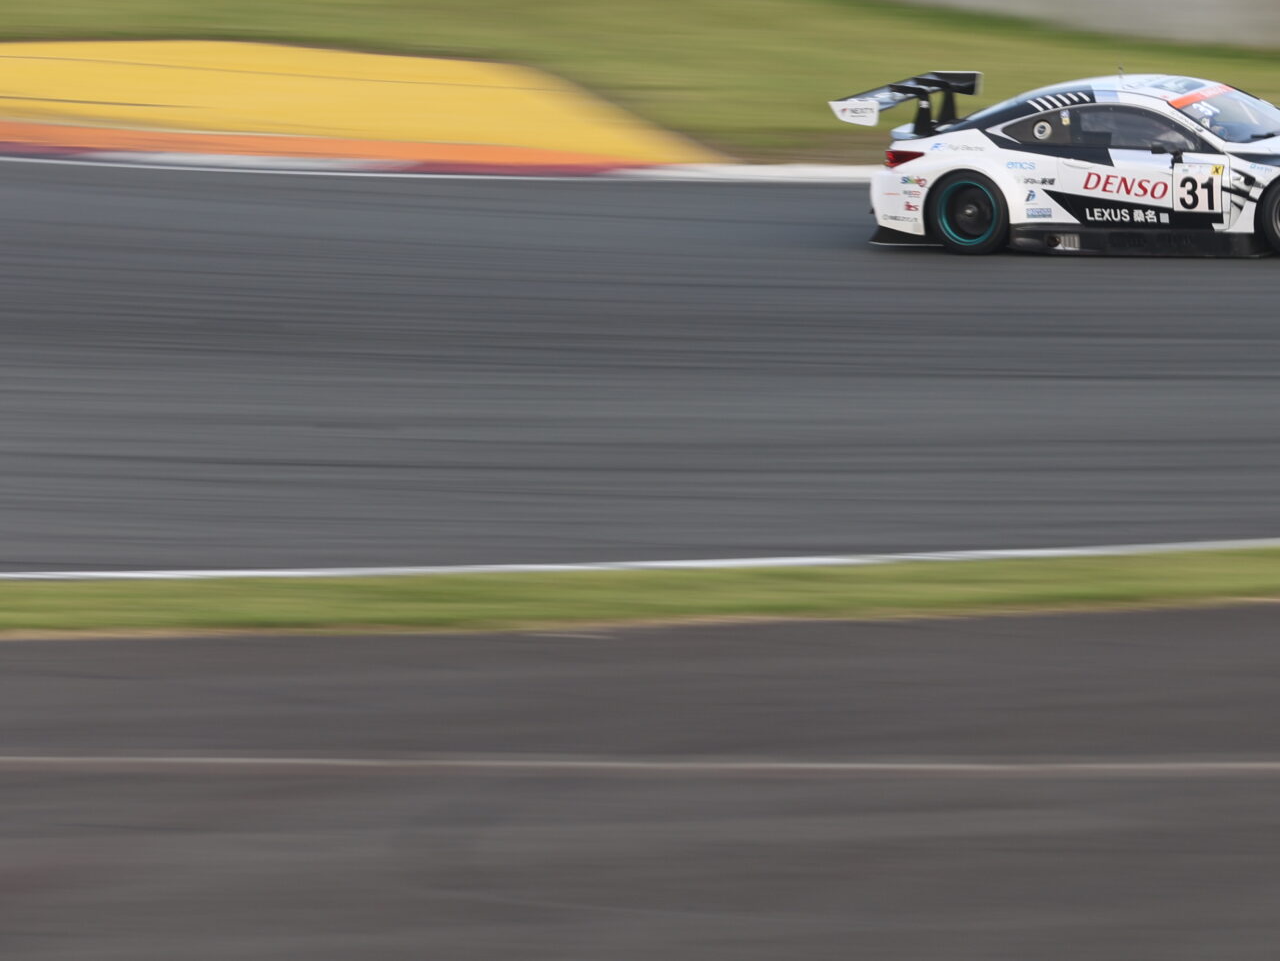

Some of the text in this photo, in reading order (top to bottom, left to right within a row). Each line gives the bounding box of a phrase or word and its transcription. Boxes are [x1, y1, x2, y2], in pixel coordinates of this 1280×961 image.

[1192, 101, 1220, 116] 31
[1083, 171, 1169, 200] DENSO
[1179, 176, 1216, 210] 31
[1085, 207, 1131, 222] LEXUS
